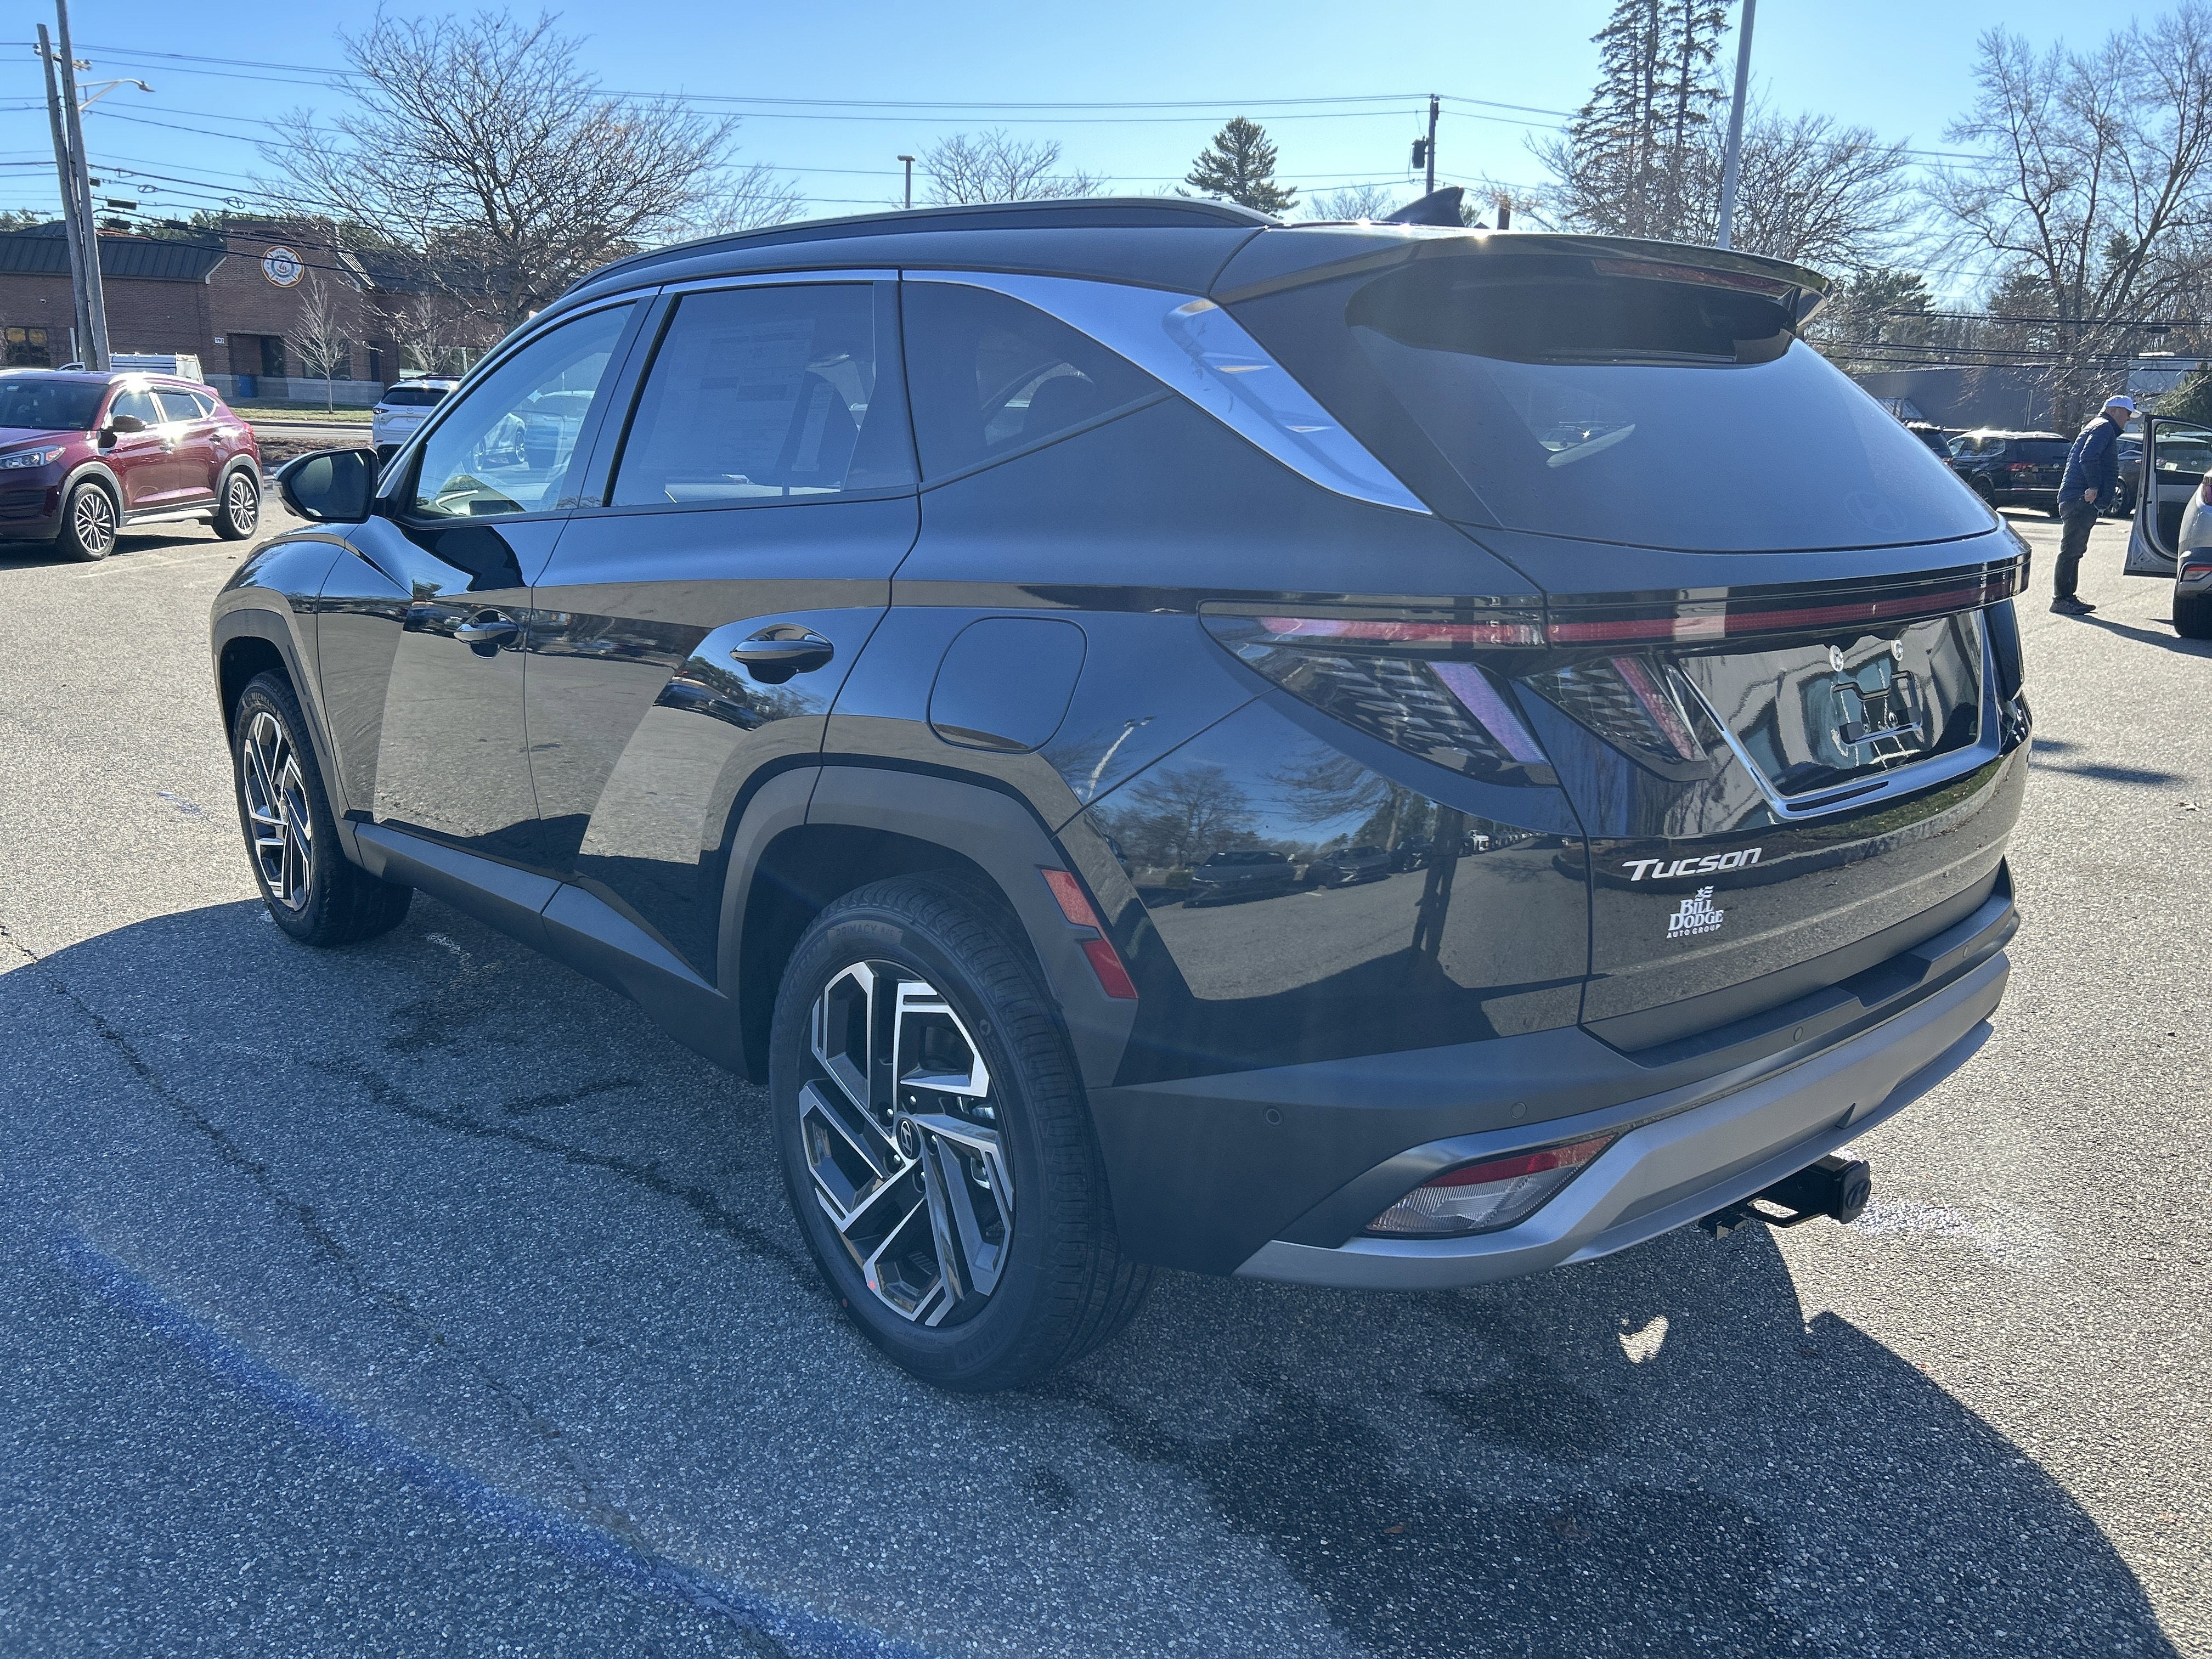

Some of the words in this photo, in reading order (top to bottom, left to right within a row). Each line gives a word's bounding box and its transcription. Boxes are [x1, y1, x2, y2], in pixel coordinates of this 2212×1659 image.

[251, 692, 276, 714] MICHELIN
[1680, 899, 1715, 916] BILL
[1668, 910, 1724, 930] DODGE
[836, 924, 877, 936] PRIMACY
[1667, 929, 1690, 939] AUTO
[1692, 923, 1721, 935] GROUP
